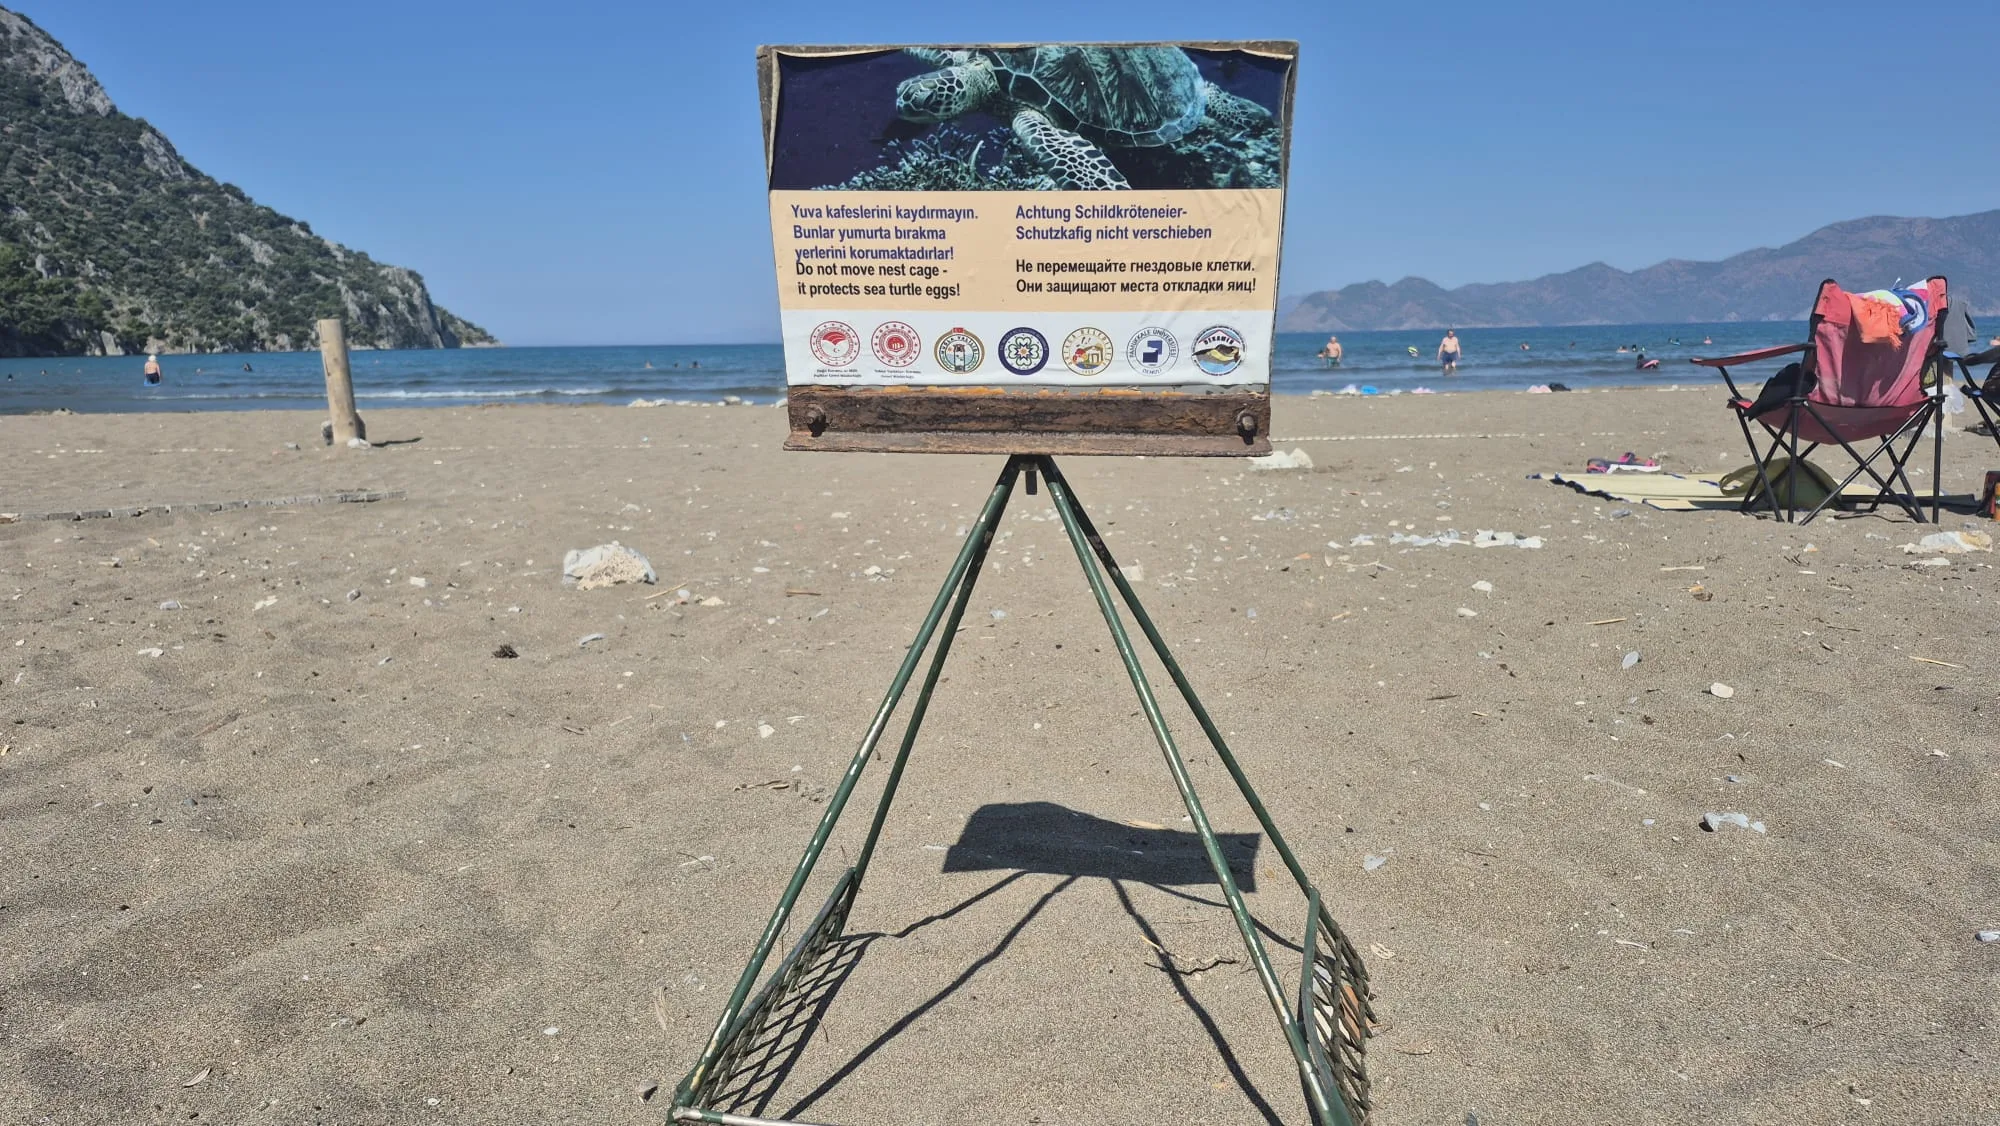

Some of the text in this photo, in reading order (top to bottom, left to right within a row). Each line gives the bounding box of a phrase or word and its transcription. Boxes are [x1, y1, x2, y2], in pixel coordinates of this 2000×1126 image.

[791, 203, 979, 223] Yuva kafeslerini kaydırmayın.
[1016, 204, 1188, 223] Achtung Schildkröteneier-
[794, 224, 947, 243] Bunlar yumurta bırakma
[1096, 225, 1129, 240] nicht
[1132, 224, 1213, 240] verschieben
[795, 246, 955, 264] yerlerini korumaktadırlar!
[796, 262, 814, 276] Do
[817, 262, 838, 276] not
[841, 265, 875, 277] move
[879, 263, 906, 277] nest
[909, 265, 940, 280] cage
[1016, 258, 1256, 276] Не перемещайте гнездовые клетки.
[798, 281, 961, 300] it protects sea turtle eggs!
[1016, 277, 1257, 296] Они защищают места откладки яиц!
